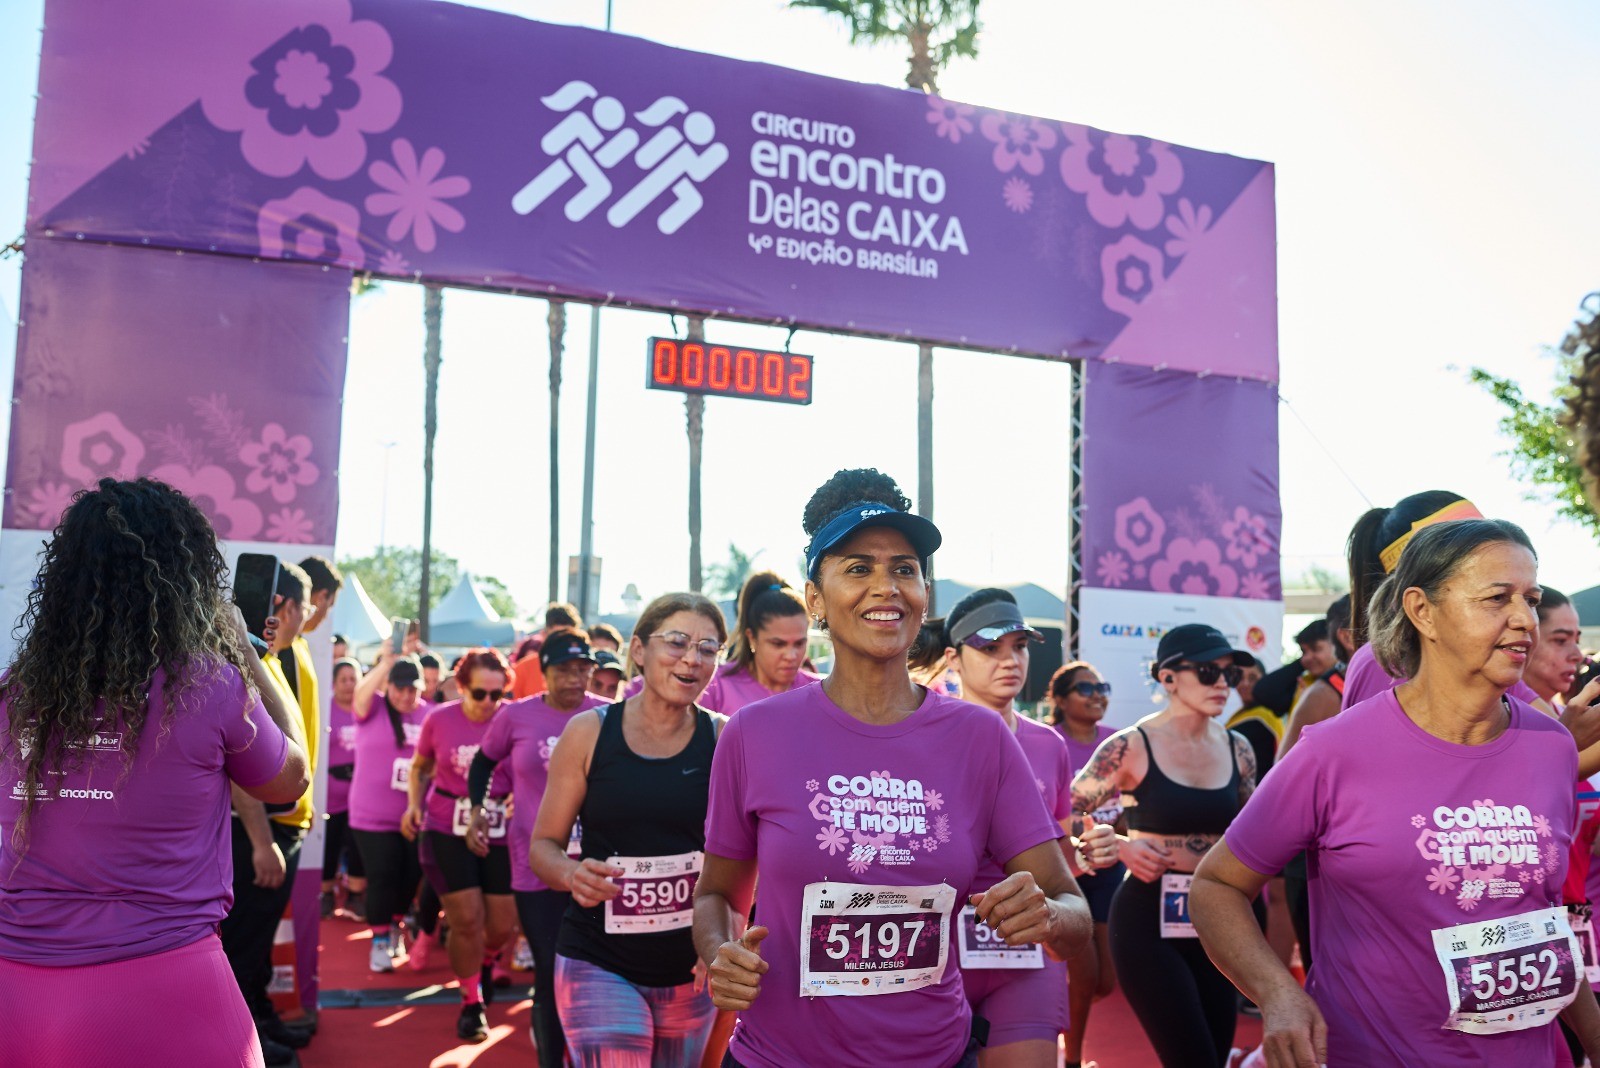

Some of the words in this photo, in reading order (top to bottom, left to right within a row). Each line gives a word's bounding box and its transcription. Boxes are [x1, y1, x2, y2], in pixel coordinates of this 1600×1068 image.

[751, 111, 855, 148] CIRCUITO
[750, 140, 946, 204] encontro
[748, 179, 841, 236] Delas
[846, 201, 969, 255] CAIXA
[776, 237, 853, 266] EDIÇÃO
[856, 249, 938, 279] BRASÍLIA
[653, 340, 811, 399] 000002
[59, 788, 114, 800] encontro
[827, 774, 923, 801] CORRA
[829, 797, 872, 811] com
[875, 798, 926, 815] quem
[1432, 804, 1534, 829] CORRA
[830, 809, 856, 830] TE
[860, 814, 927, 834] MOVE
[1436, 830, 1480, 845] com
[1484, 829, 1538, 846] quem
[880, 848, 911, 856] encontro
[1438, 845, 1466, 866] TE
[1470, 844, 1540, 865] MOVE
[622, 878, 690, 908] 5590
[819, 898, 835, 910] 5KM
[825, 919, 926, 961] 5197
[844, 961, 876, 971] MILENA
[879, 960, 905, 970] JESUS
[1470, 948, 1562, 1001] 5552
[1476, 996, 1525, 1011] MARGARETE
